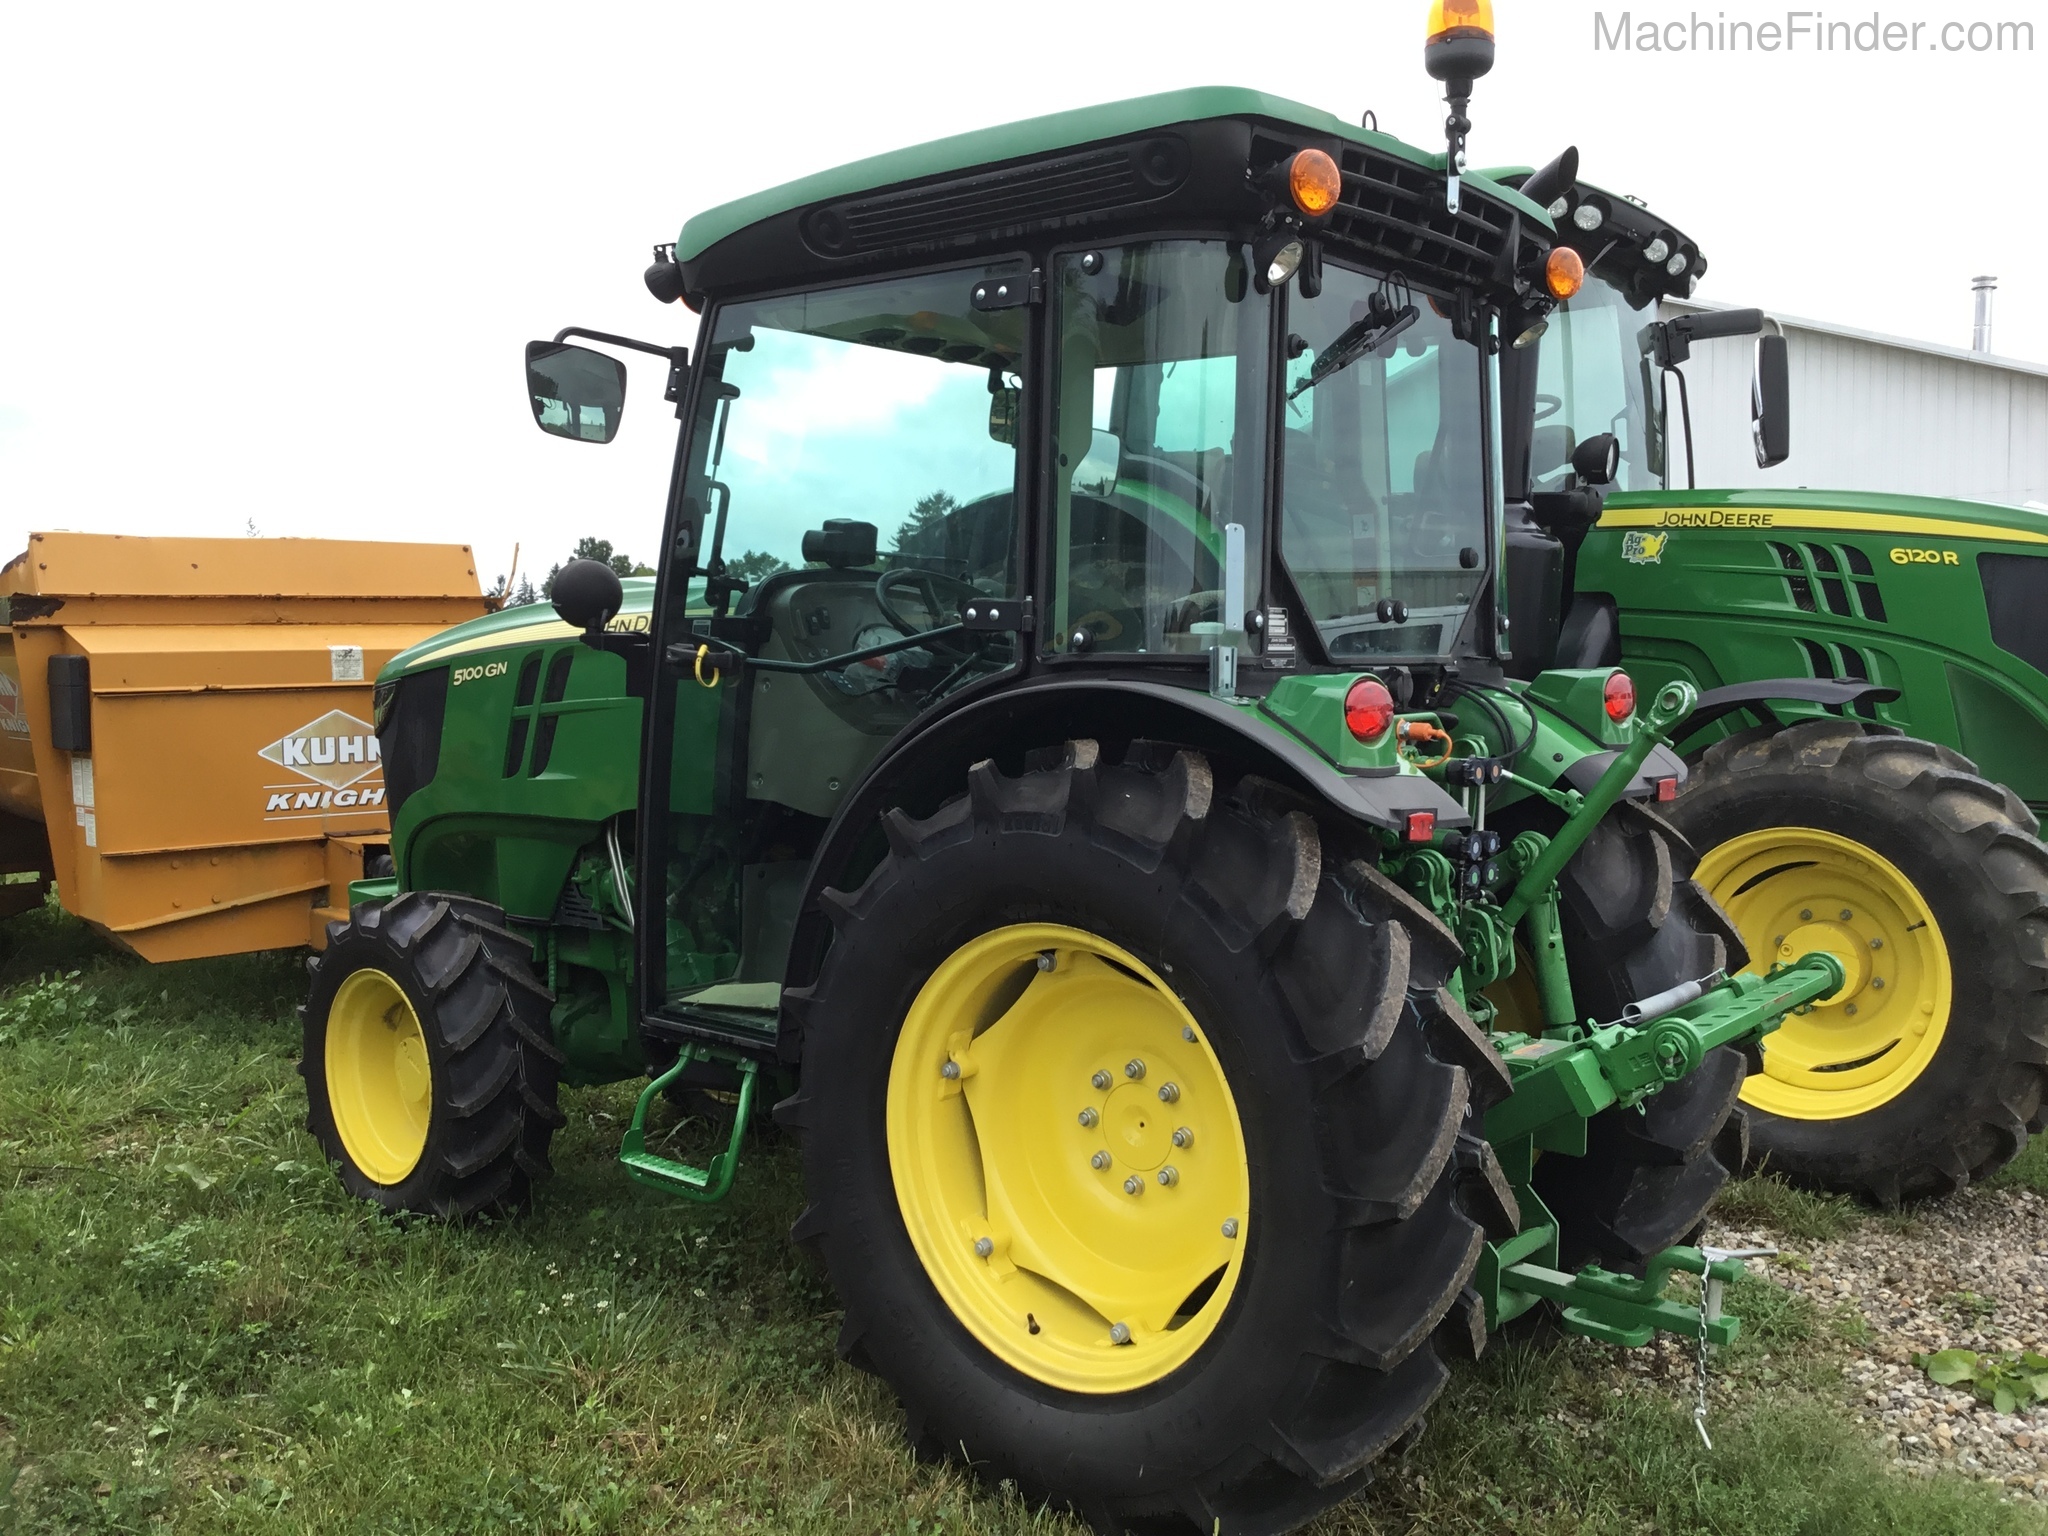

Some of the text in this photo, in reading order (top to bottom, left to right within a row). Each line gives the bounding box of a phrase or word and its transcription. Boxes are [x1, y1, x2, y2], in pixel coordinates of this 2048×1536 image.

[1656, 510, 1774, 526] JOHN DEERE
[1624, 545, 1646, 557] Pro
[1889, 547, 1960, 566] 6120 R
[606, 618, 632, 633] HN
[453, 661, 508, 686] 5100 GN
[265, 787, 386, 812] KNIGH
